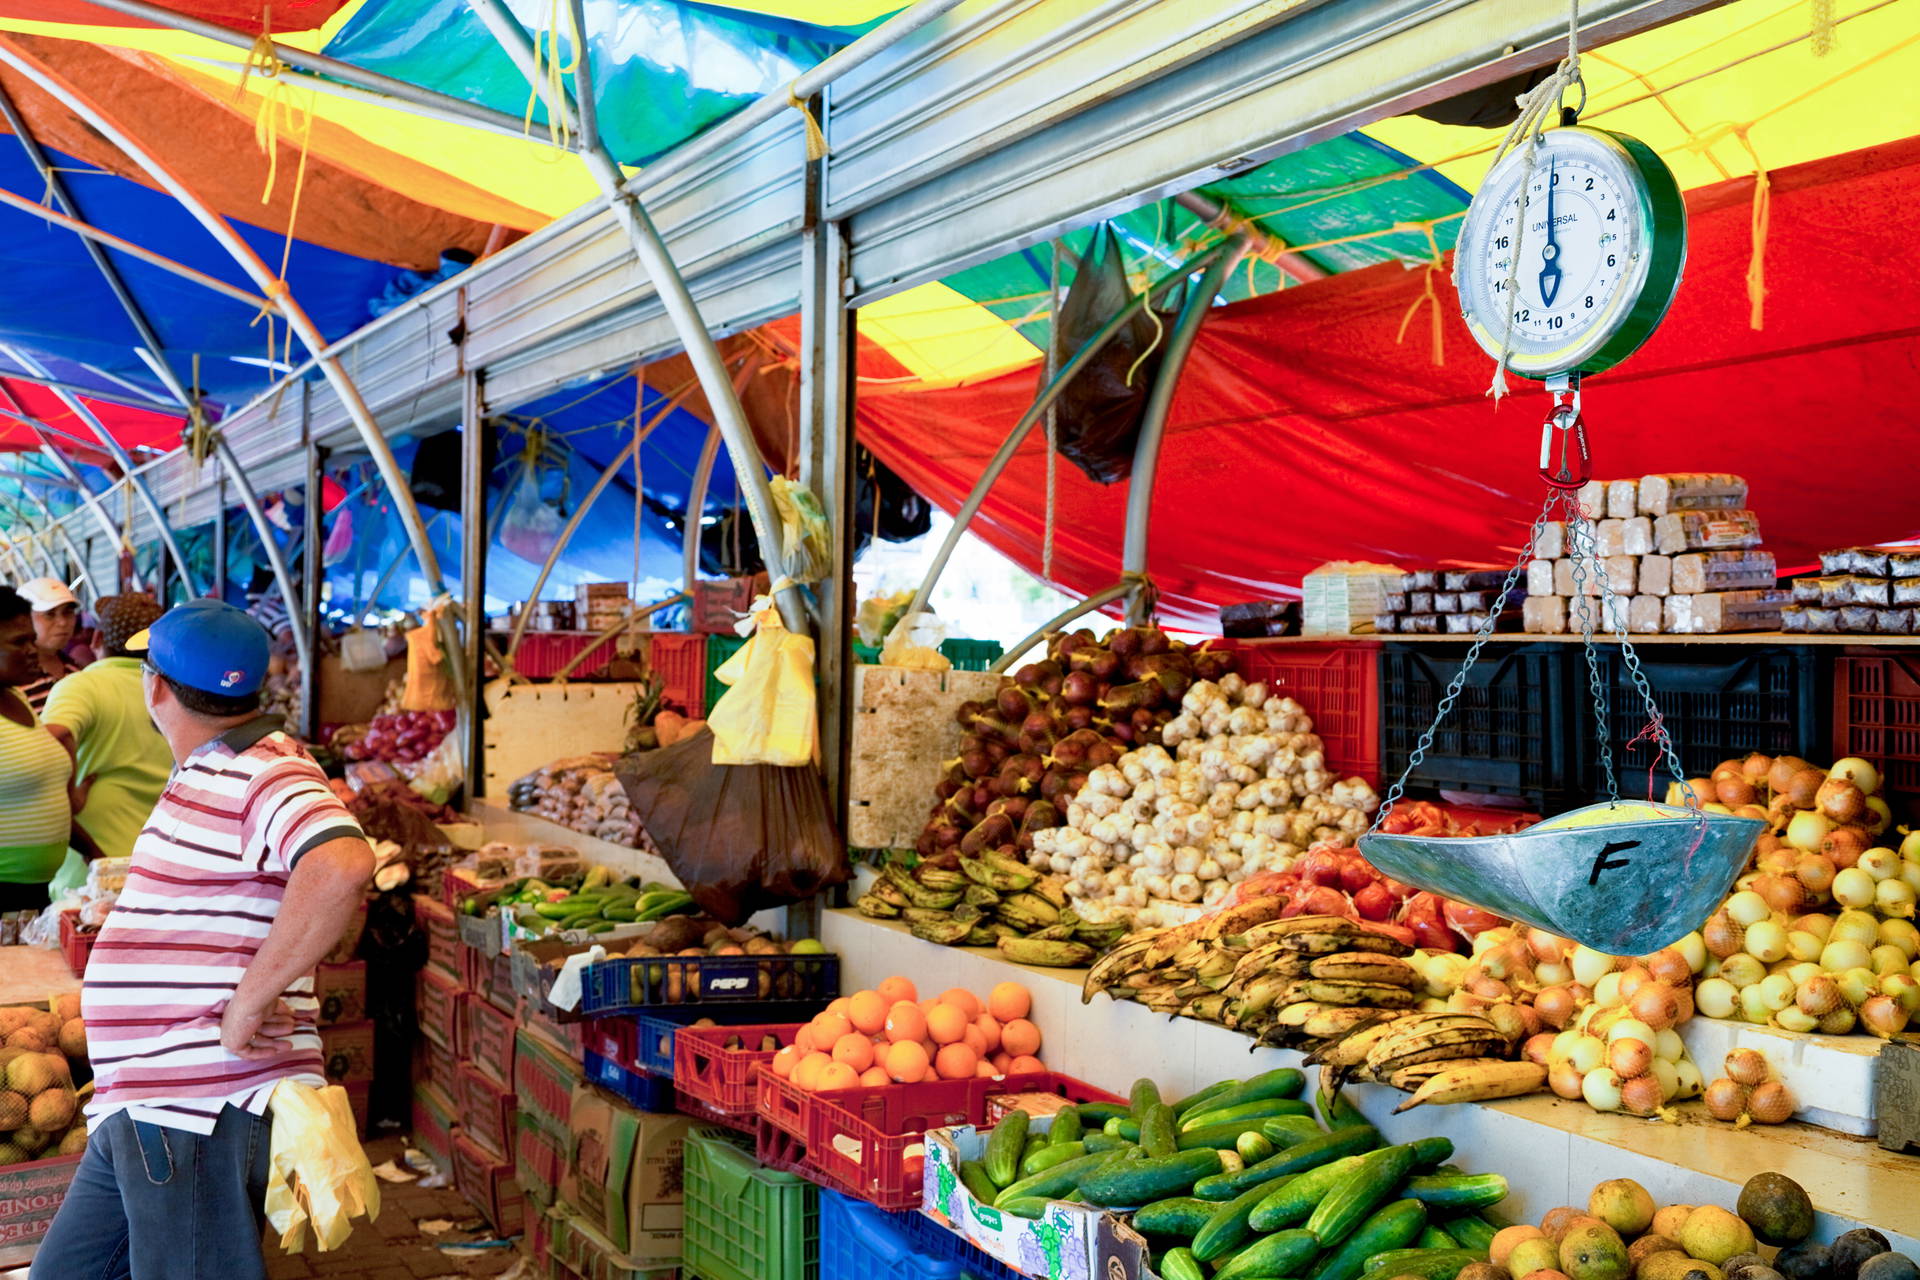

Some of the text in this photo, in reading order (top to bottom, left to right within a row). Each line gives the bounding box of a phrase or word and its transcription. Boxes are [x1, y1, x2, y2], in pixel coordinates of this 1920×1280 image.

[1533, 184, 1542, 192] 19
[1585, 177, 1594, 191] 2
[1600, 193, 1606, 201] 3
[1506, 217, 1514, 225] 17
[1606, 208, 1616, 221] 4
[1495, 236, 1509, 250] 16
[1612, 233, 1617, 241] 5
[1495, 261, 1503, 269] 15
[1607, 254, 1616, 267] 6
[1585, 295, 1594, 308] 8
[1513, 309, 1530, 323] 12
[1570, 312, 1576, 320] 9
[1533, 319, 1541, 327] 11
[1546, 316, 1563, 330] 10
[1589, 839, 1642, 885] F
[710, 976, 749, 990] PEPSI
